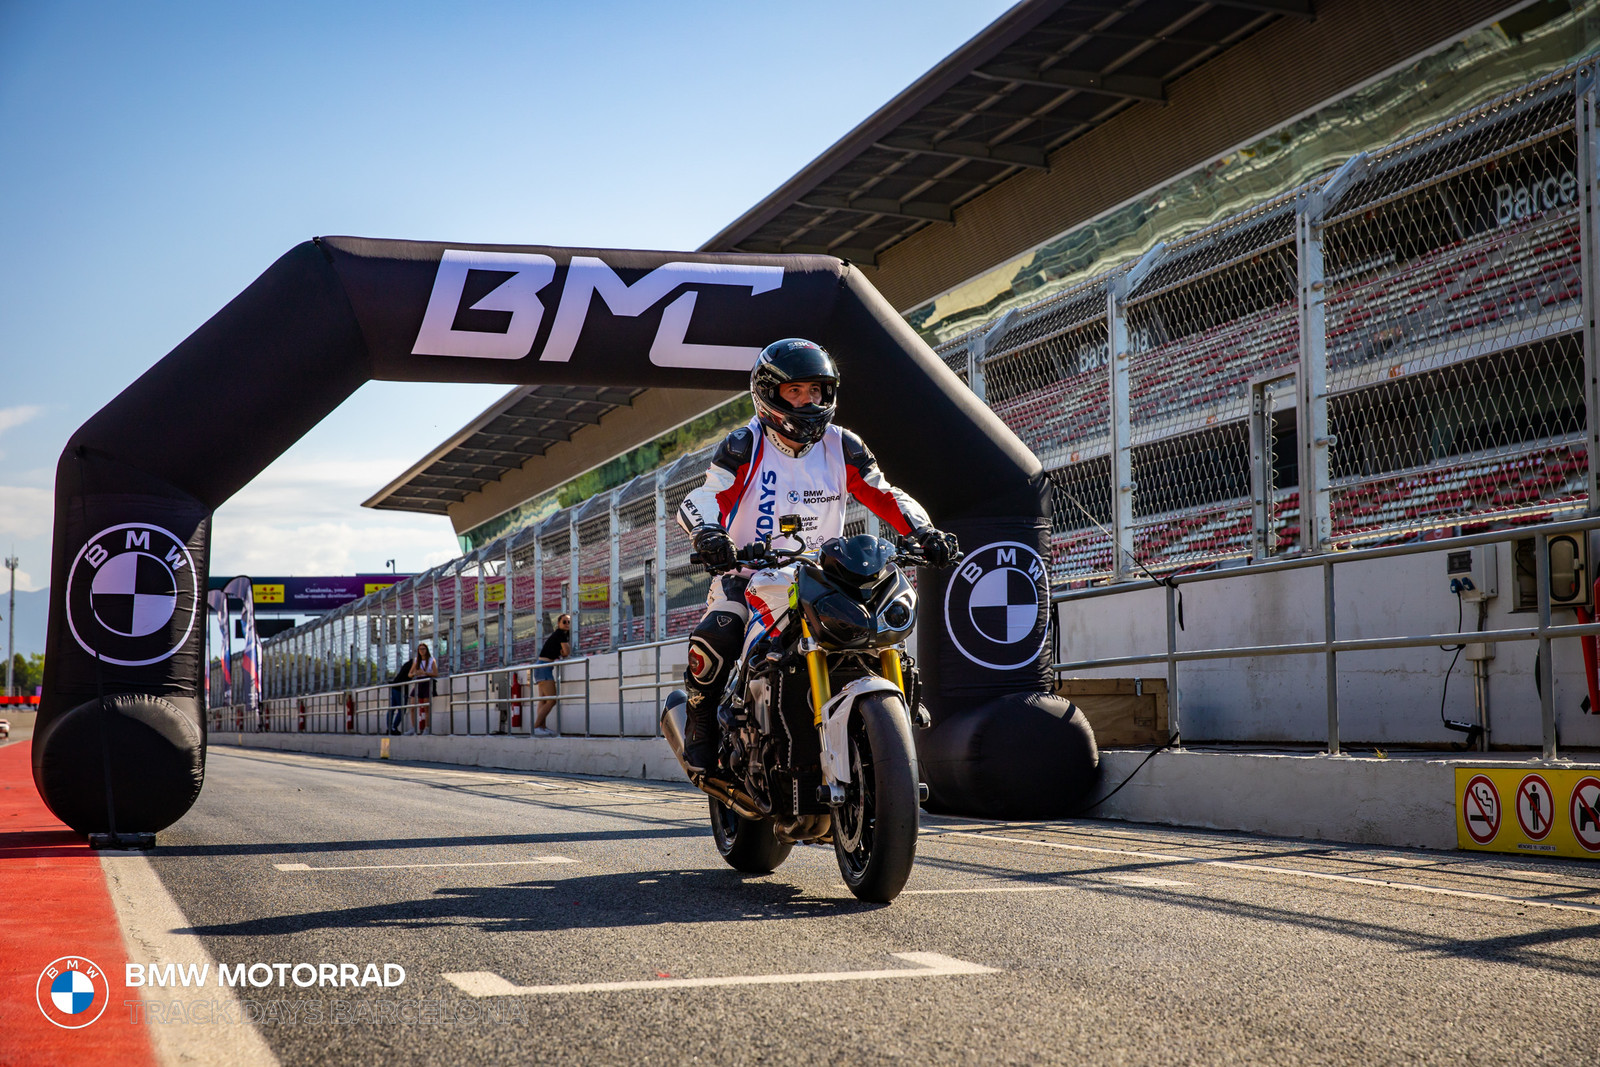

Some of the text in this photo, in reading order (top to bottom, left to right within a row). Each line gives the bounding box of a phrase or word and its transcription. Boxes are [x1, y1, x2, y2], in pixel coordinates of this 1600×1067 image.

[411, 249, 784, 371] BMC
[84, 530, 188, 571] BMW
[961, 548, 1044, 585] BMW
